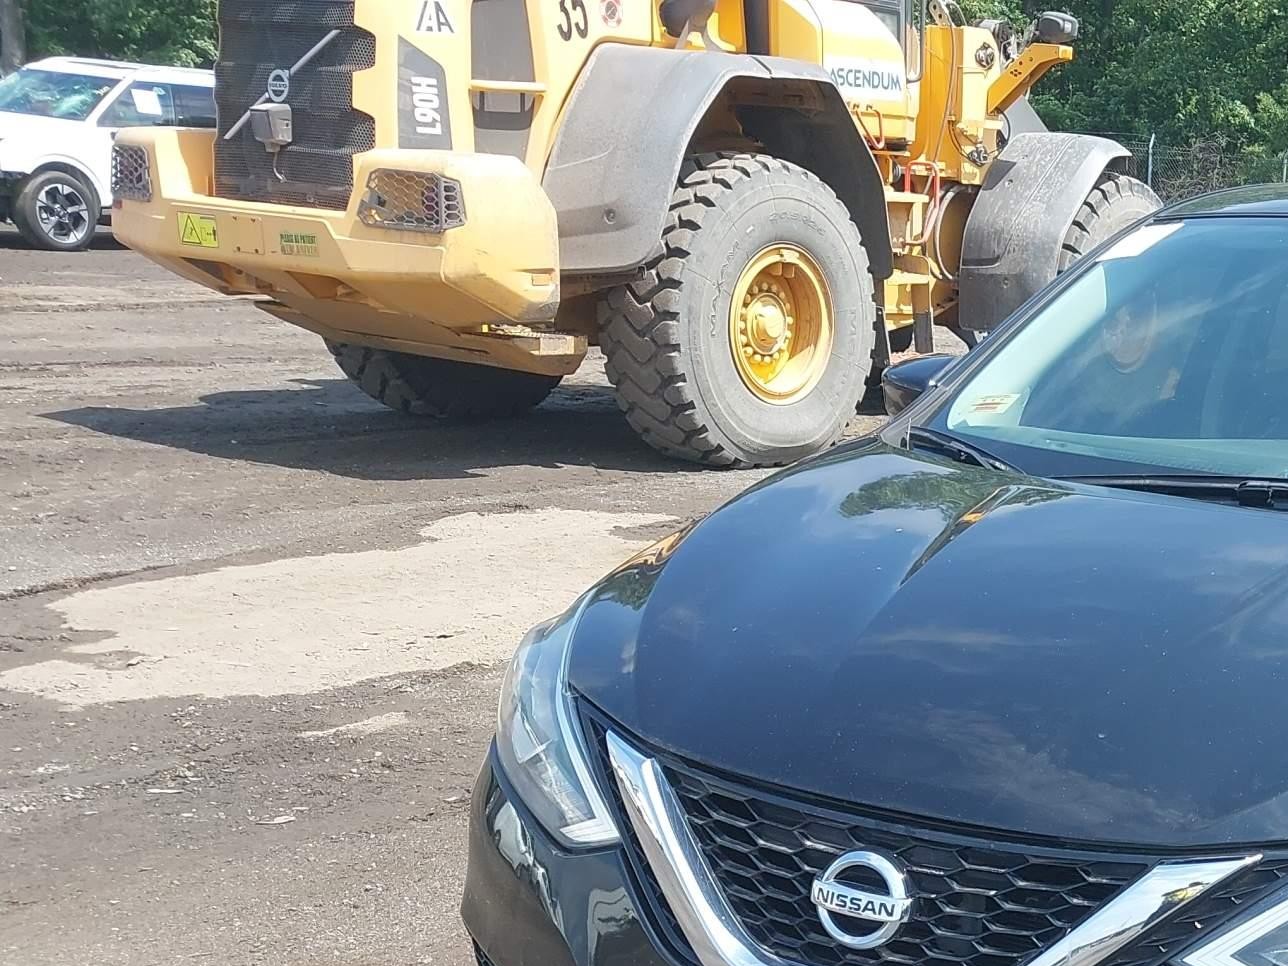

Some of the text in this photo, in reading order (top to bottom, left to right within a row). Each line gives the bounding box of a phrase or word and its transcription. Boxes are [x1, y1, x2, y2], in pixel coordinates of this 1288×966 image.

[831, 68, 902, 91] ASCENDUM
[411, 76, 442, 135] L90H
[817, 887, 895, 918] NISSAN
